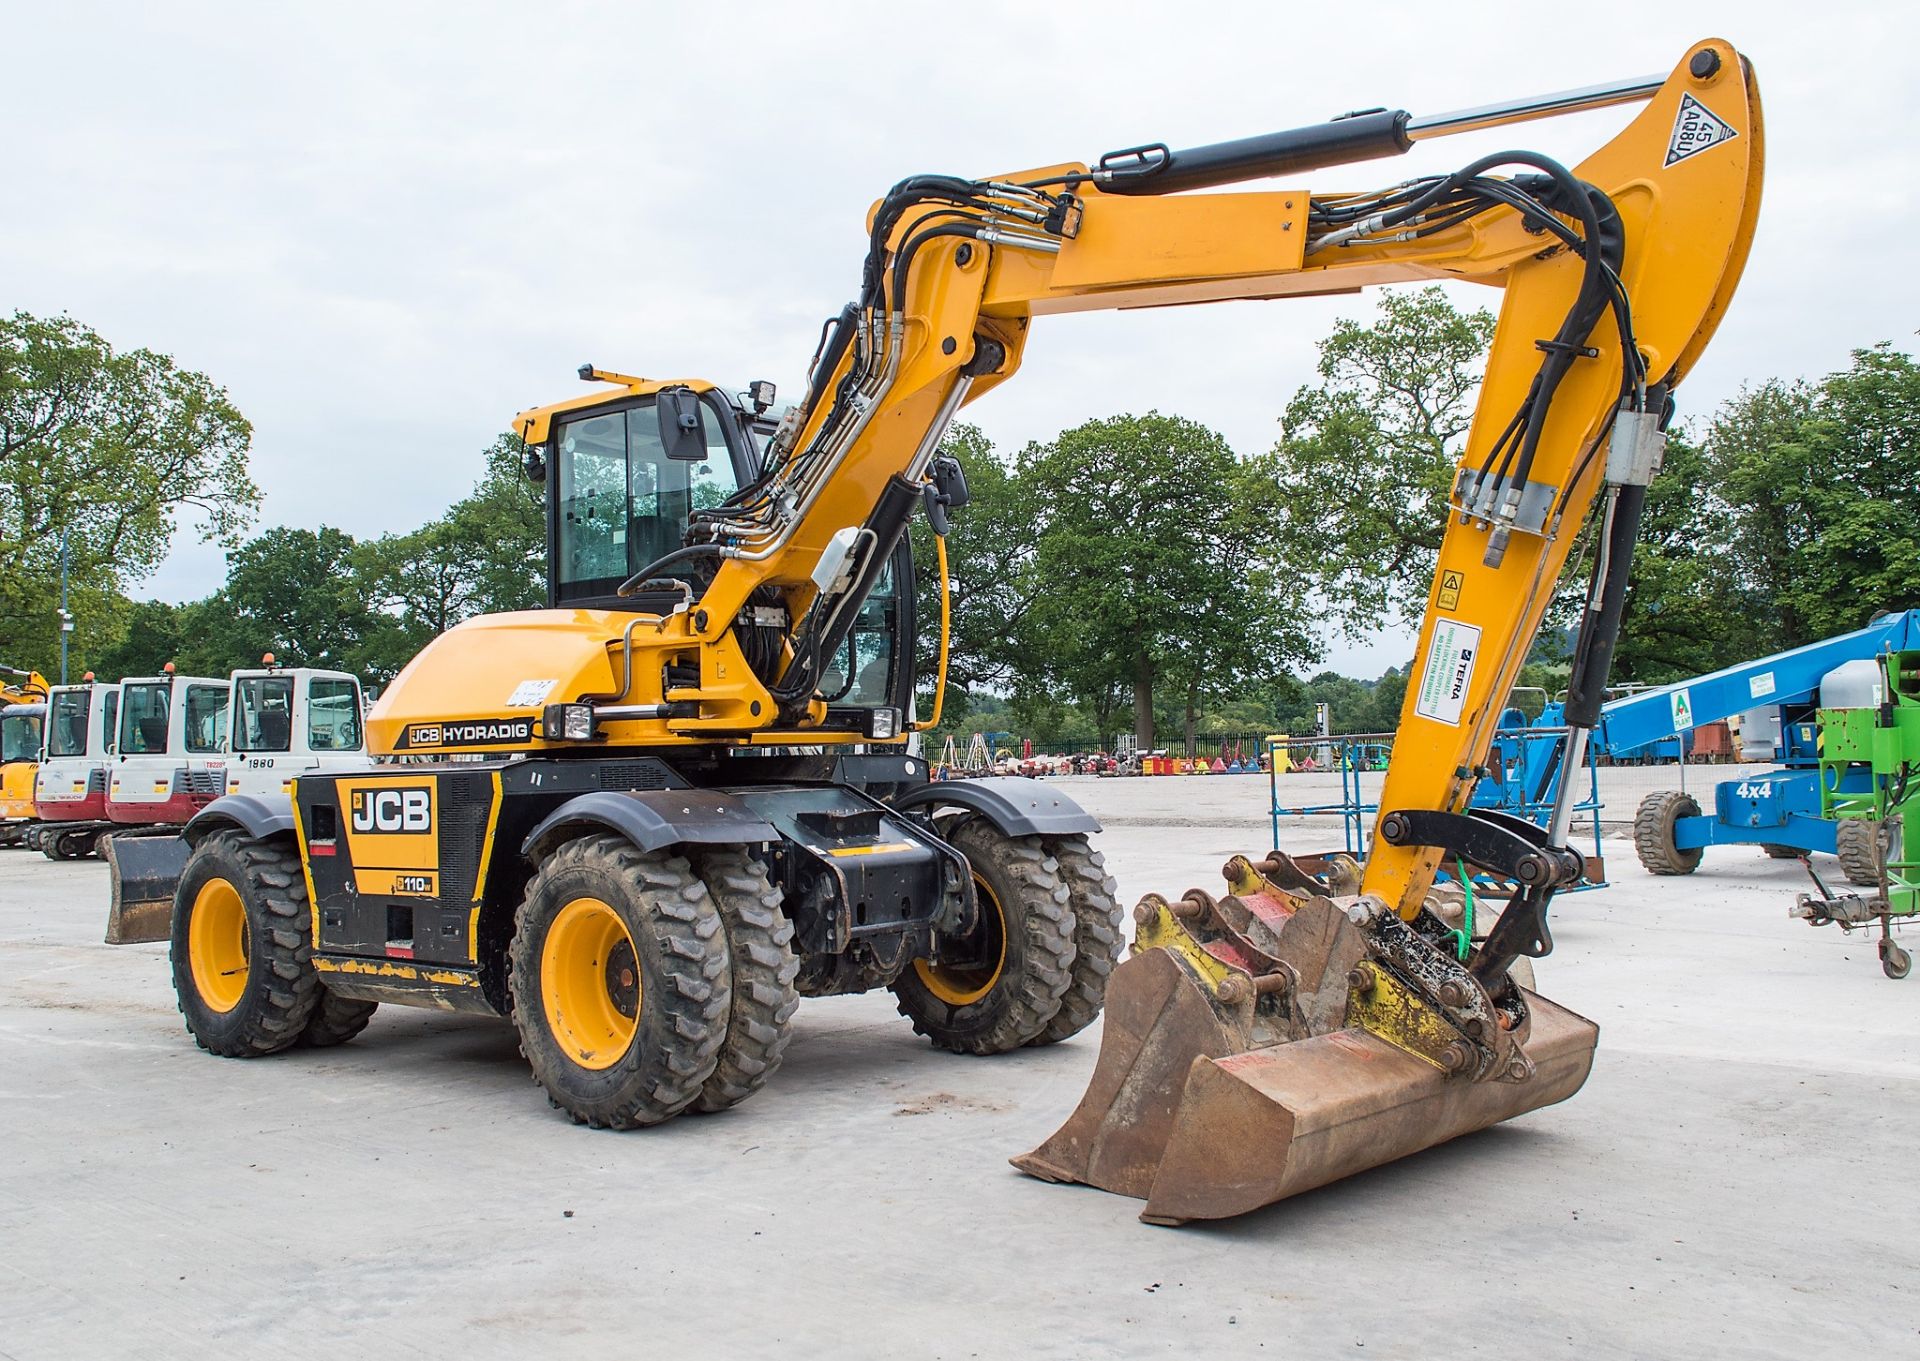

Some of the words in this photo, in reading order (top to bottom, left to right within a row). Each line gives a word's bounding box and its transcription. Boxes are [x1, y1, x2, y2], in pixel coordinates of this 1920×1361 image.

[1696, 122, 1714, 142] 45
[1438, 635, 1444, 643] NO
[1446, 627, 1455, 648] DOUBLE
[1432, 643, 1441, 664] SAFETY
[1440, 648, 1450, 671] LOCKING
[1450, 649, 1459, 665] FULLY
[1424, 674, 1434, 702] REQUIRED
[1435, 671, 1444, 695] COUPLER
[1444, 665, 1454, 696] AUTOMATIC
[1451, 663, 1467, 700] TEFRA
[411, 728, 440, 744] JCB
[442, 723, 528, 741] HYDRADIG
[249, 758, 274, 768] 1980
[1735, 782, 1772, 799] 4x4
[353, 790, 430, 832] JCB
